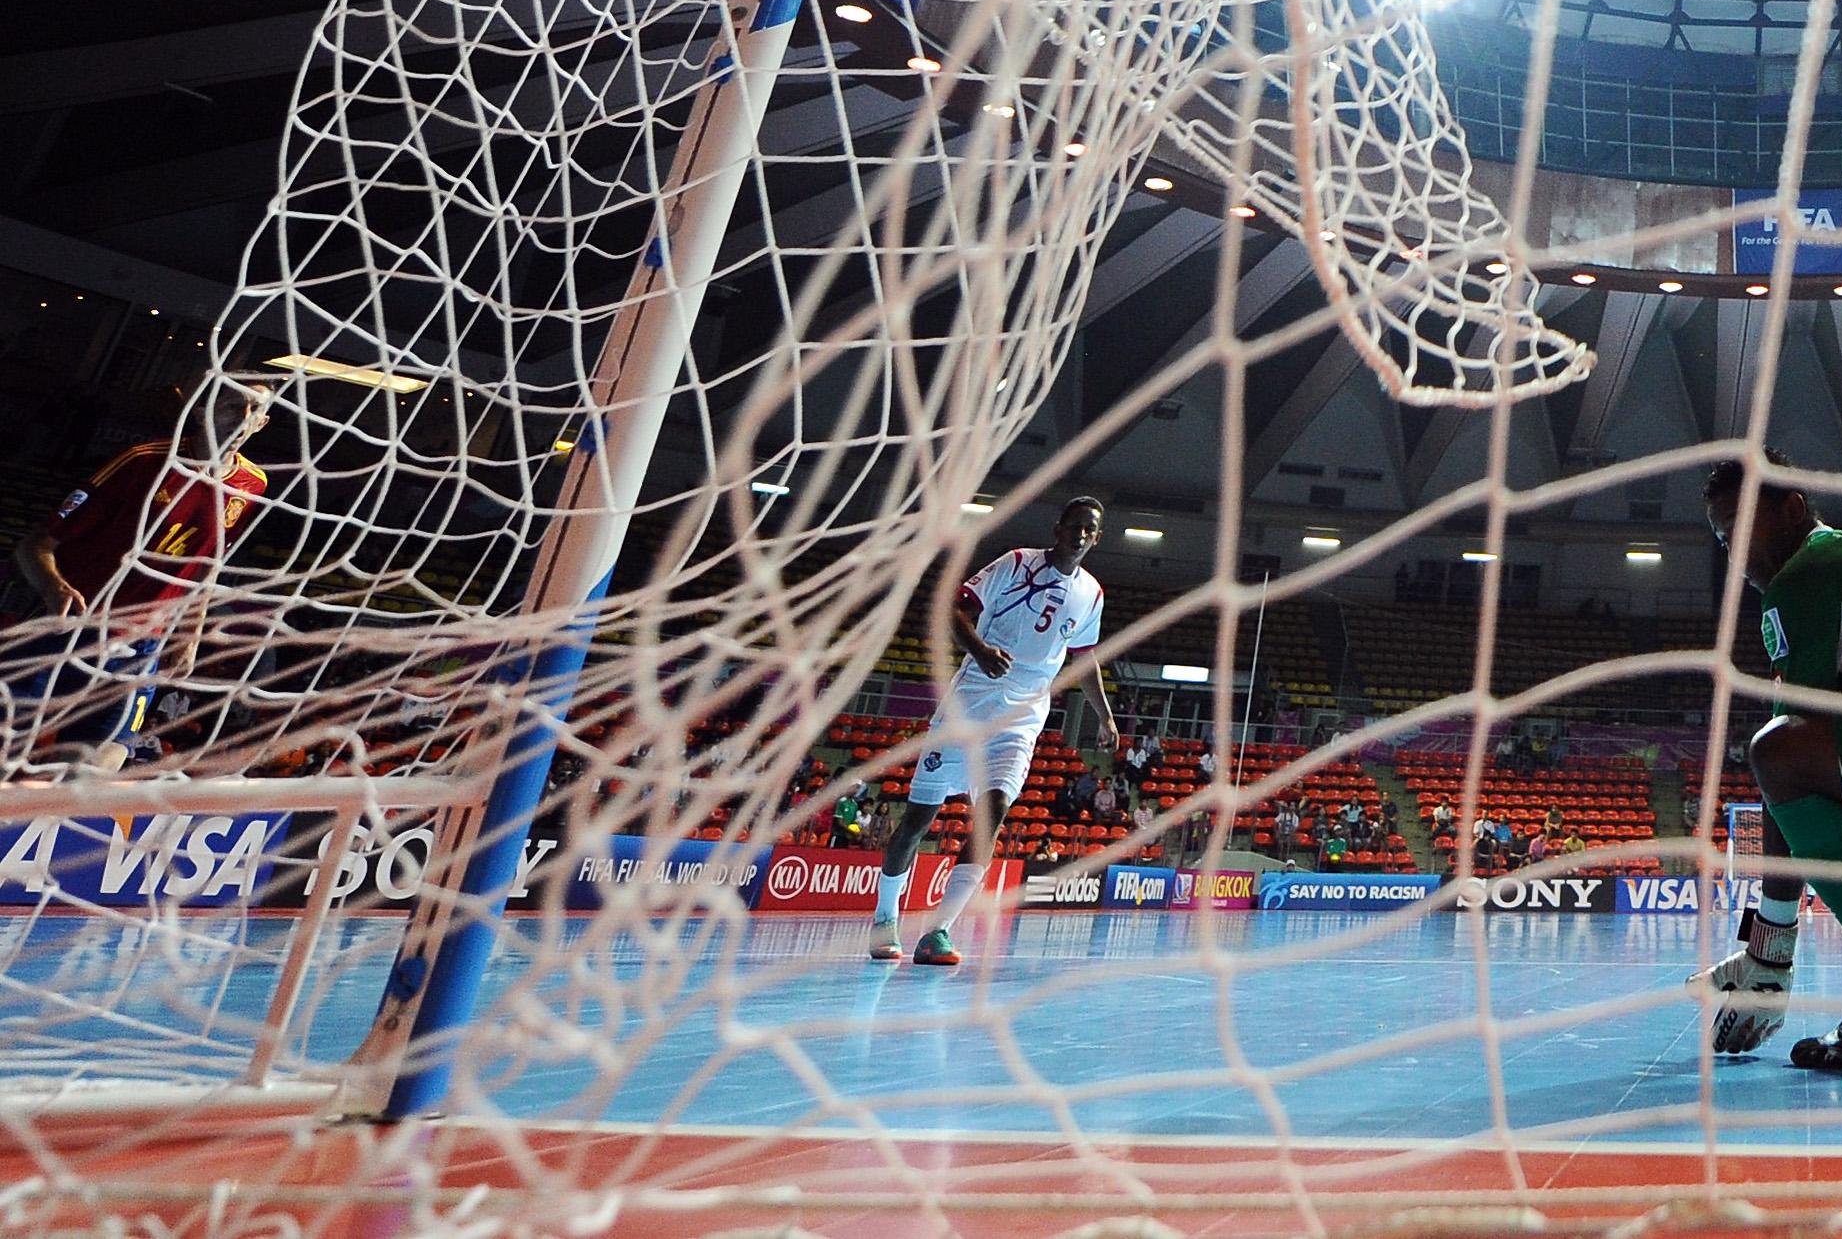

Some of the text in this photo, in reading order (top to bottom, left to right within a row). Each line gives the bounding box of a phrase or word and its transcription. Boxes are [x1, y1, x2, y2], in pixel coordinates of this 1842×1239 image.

[1763, 208, 1837, 232] FFA
[155, 523, 199, 558] 14
[1034, 605, 1057, 633] 5
[100, 814, 268, 896] VISA
[304, 825, 558, 900] SOY
[578, 857, 614, 882] FIFA
[616, 859, 673, 886] FUAL
[677, 862, 728, 886] WOLD
[774, 865, 802, 890] KIA
[808, 864, 839, 893] KIA
[842, 865, 907, 896] MOT
[1055, 871, 1100, 902] adidas
[1289, 884, 1426, 900] SAY NO TO RACISM
[1456, 877, 1603, 909] SONY
[1622, 879, 1699, 910] VISA
[1713, 879, 1764, 909] VIS
